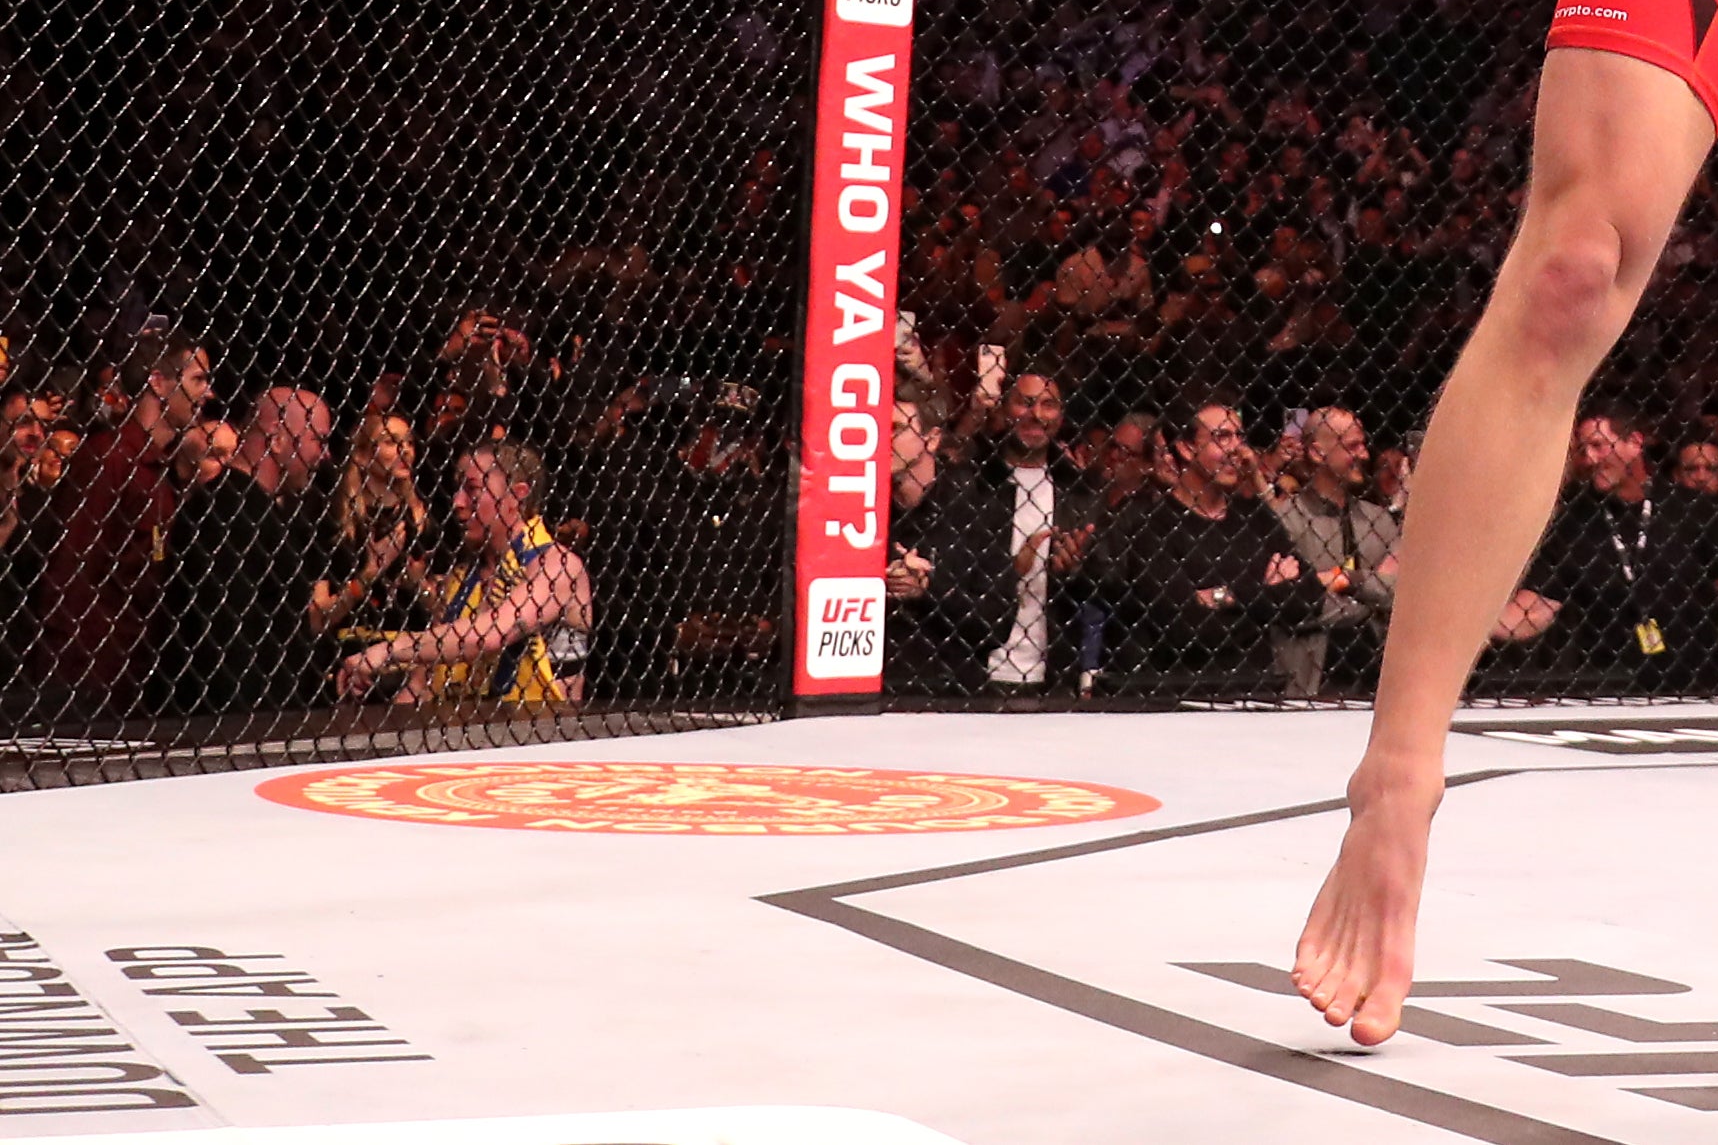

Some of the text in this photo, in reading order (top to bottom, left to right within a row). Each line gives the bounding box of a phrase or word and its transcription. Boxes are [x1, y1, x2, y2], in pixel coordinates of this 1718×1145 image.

[825, 54, 896, 549] WHO YA GOT?
[818, 629, 875, 657] PICKS
[821, 597, 877, 623] UFC
[104, 946, 436, 1074] THE APP
